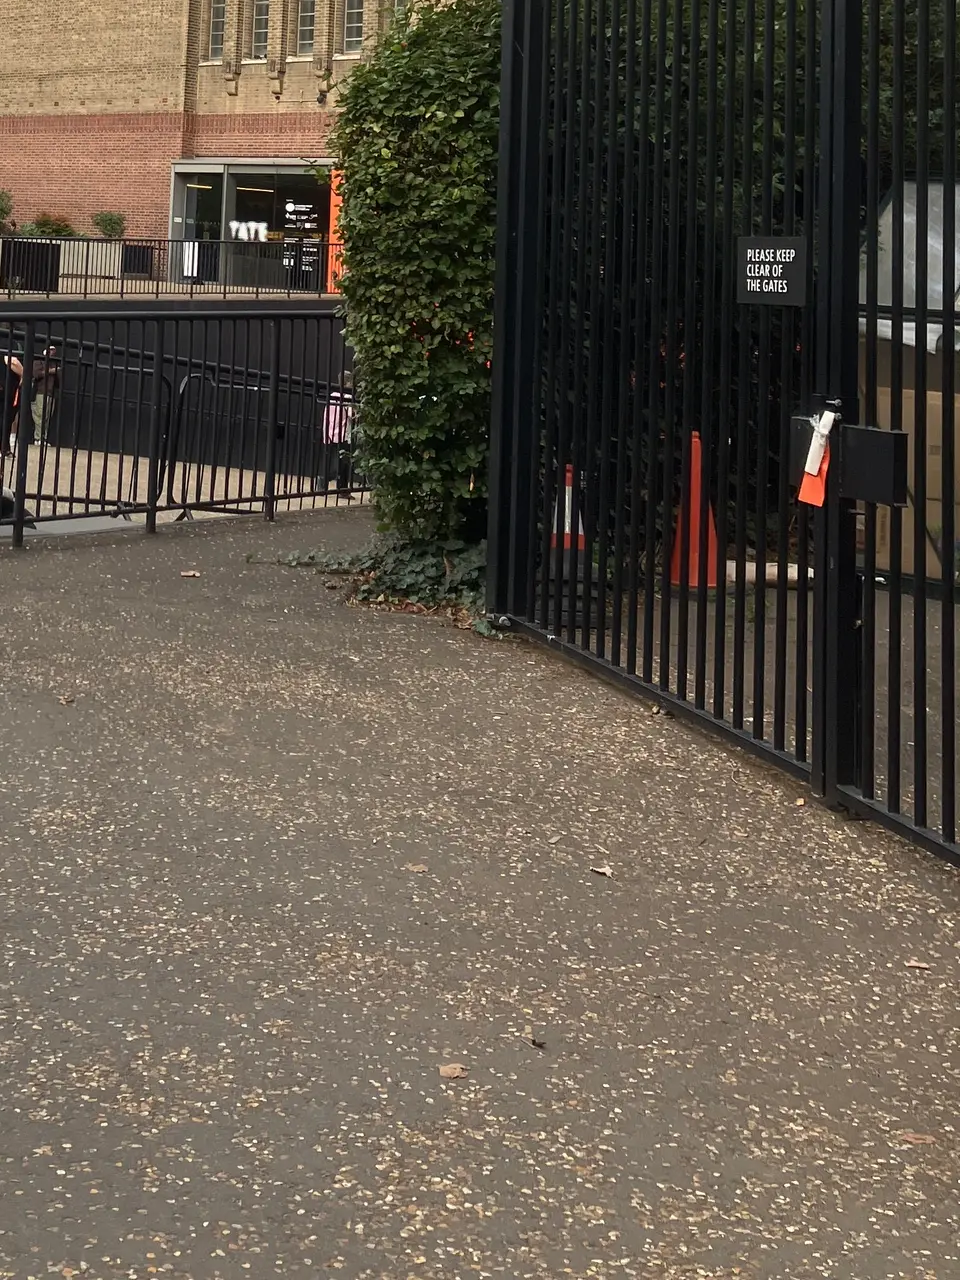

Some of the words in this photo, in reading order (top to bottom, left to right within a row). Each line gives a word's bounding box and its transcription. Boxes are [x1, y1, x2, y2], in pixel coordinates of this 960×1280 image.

[229, 220, 268, 242] TATE
[747, 249, 774, 261] PLEASE
[776, 249, 796, 262] KEEP
[746, 264, 770, 276] CLEAR
[772, 264, 783, 277] OF
[746, 278, 761, 292] THE
[762, 279, 788, 293] GATES
